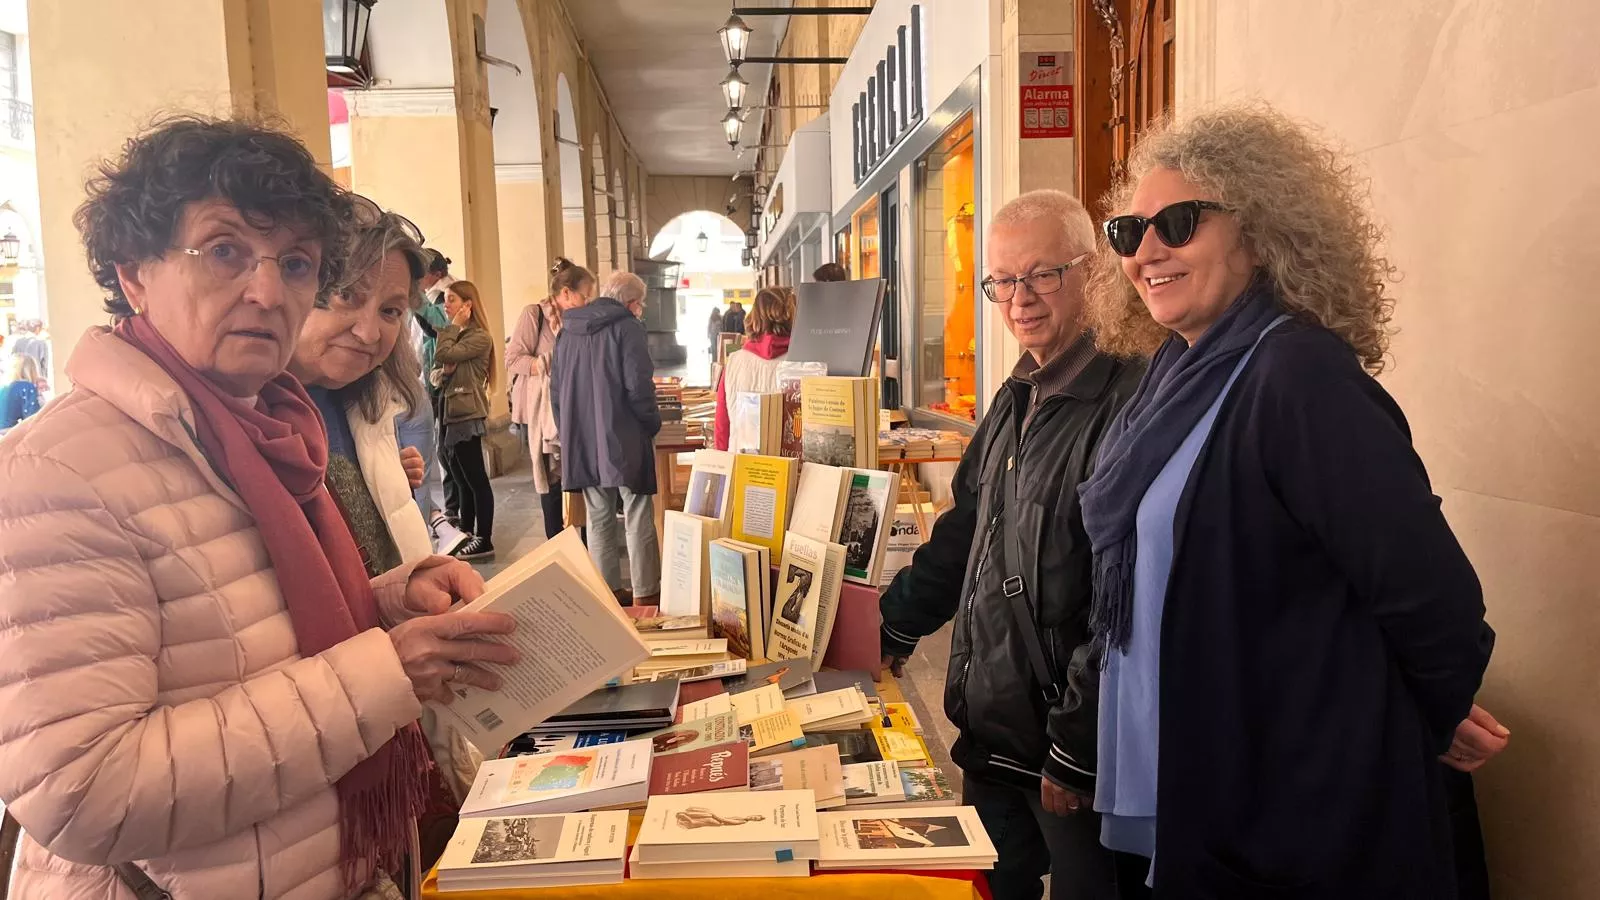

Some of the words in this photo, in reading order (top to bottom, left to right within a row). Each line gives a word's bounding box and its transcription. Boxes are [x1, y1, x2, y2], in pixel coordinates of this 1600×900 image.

[1024, 88, 1070, 100] Alarma
[790, 540, 818, 560] Fuellas
[702, 750, 732, 782] Repués
